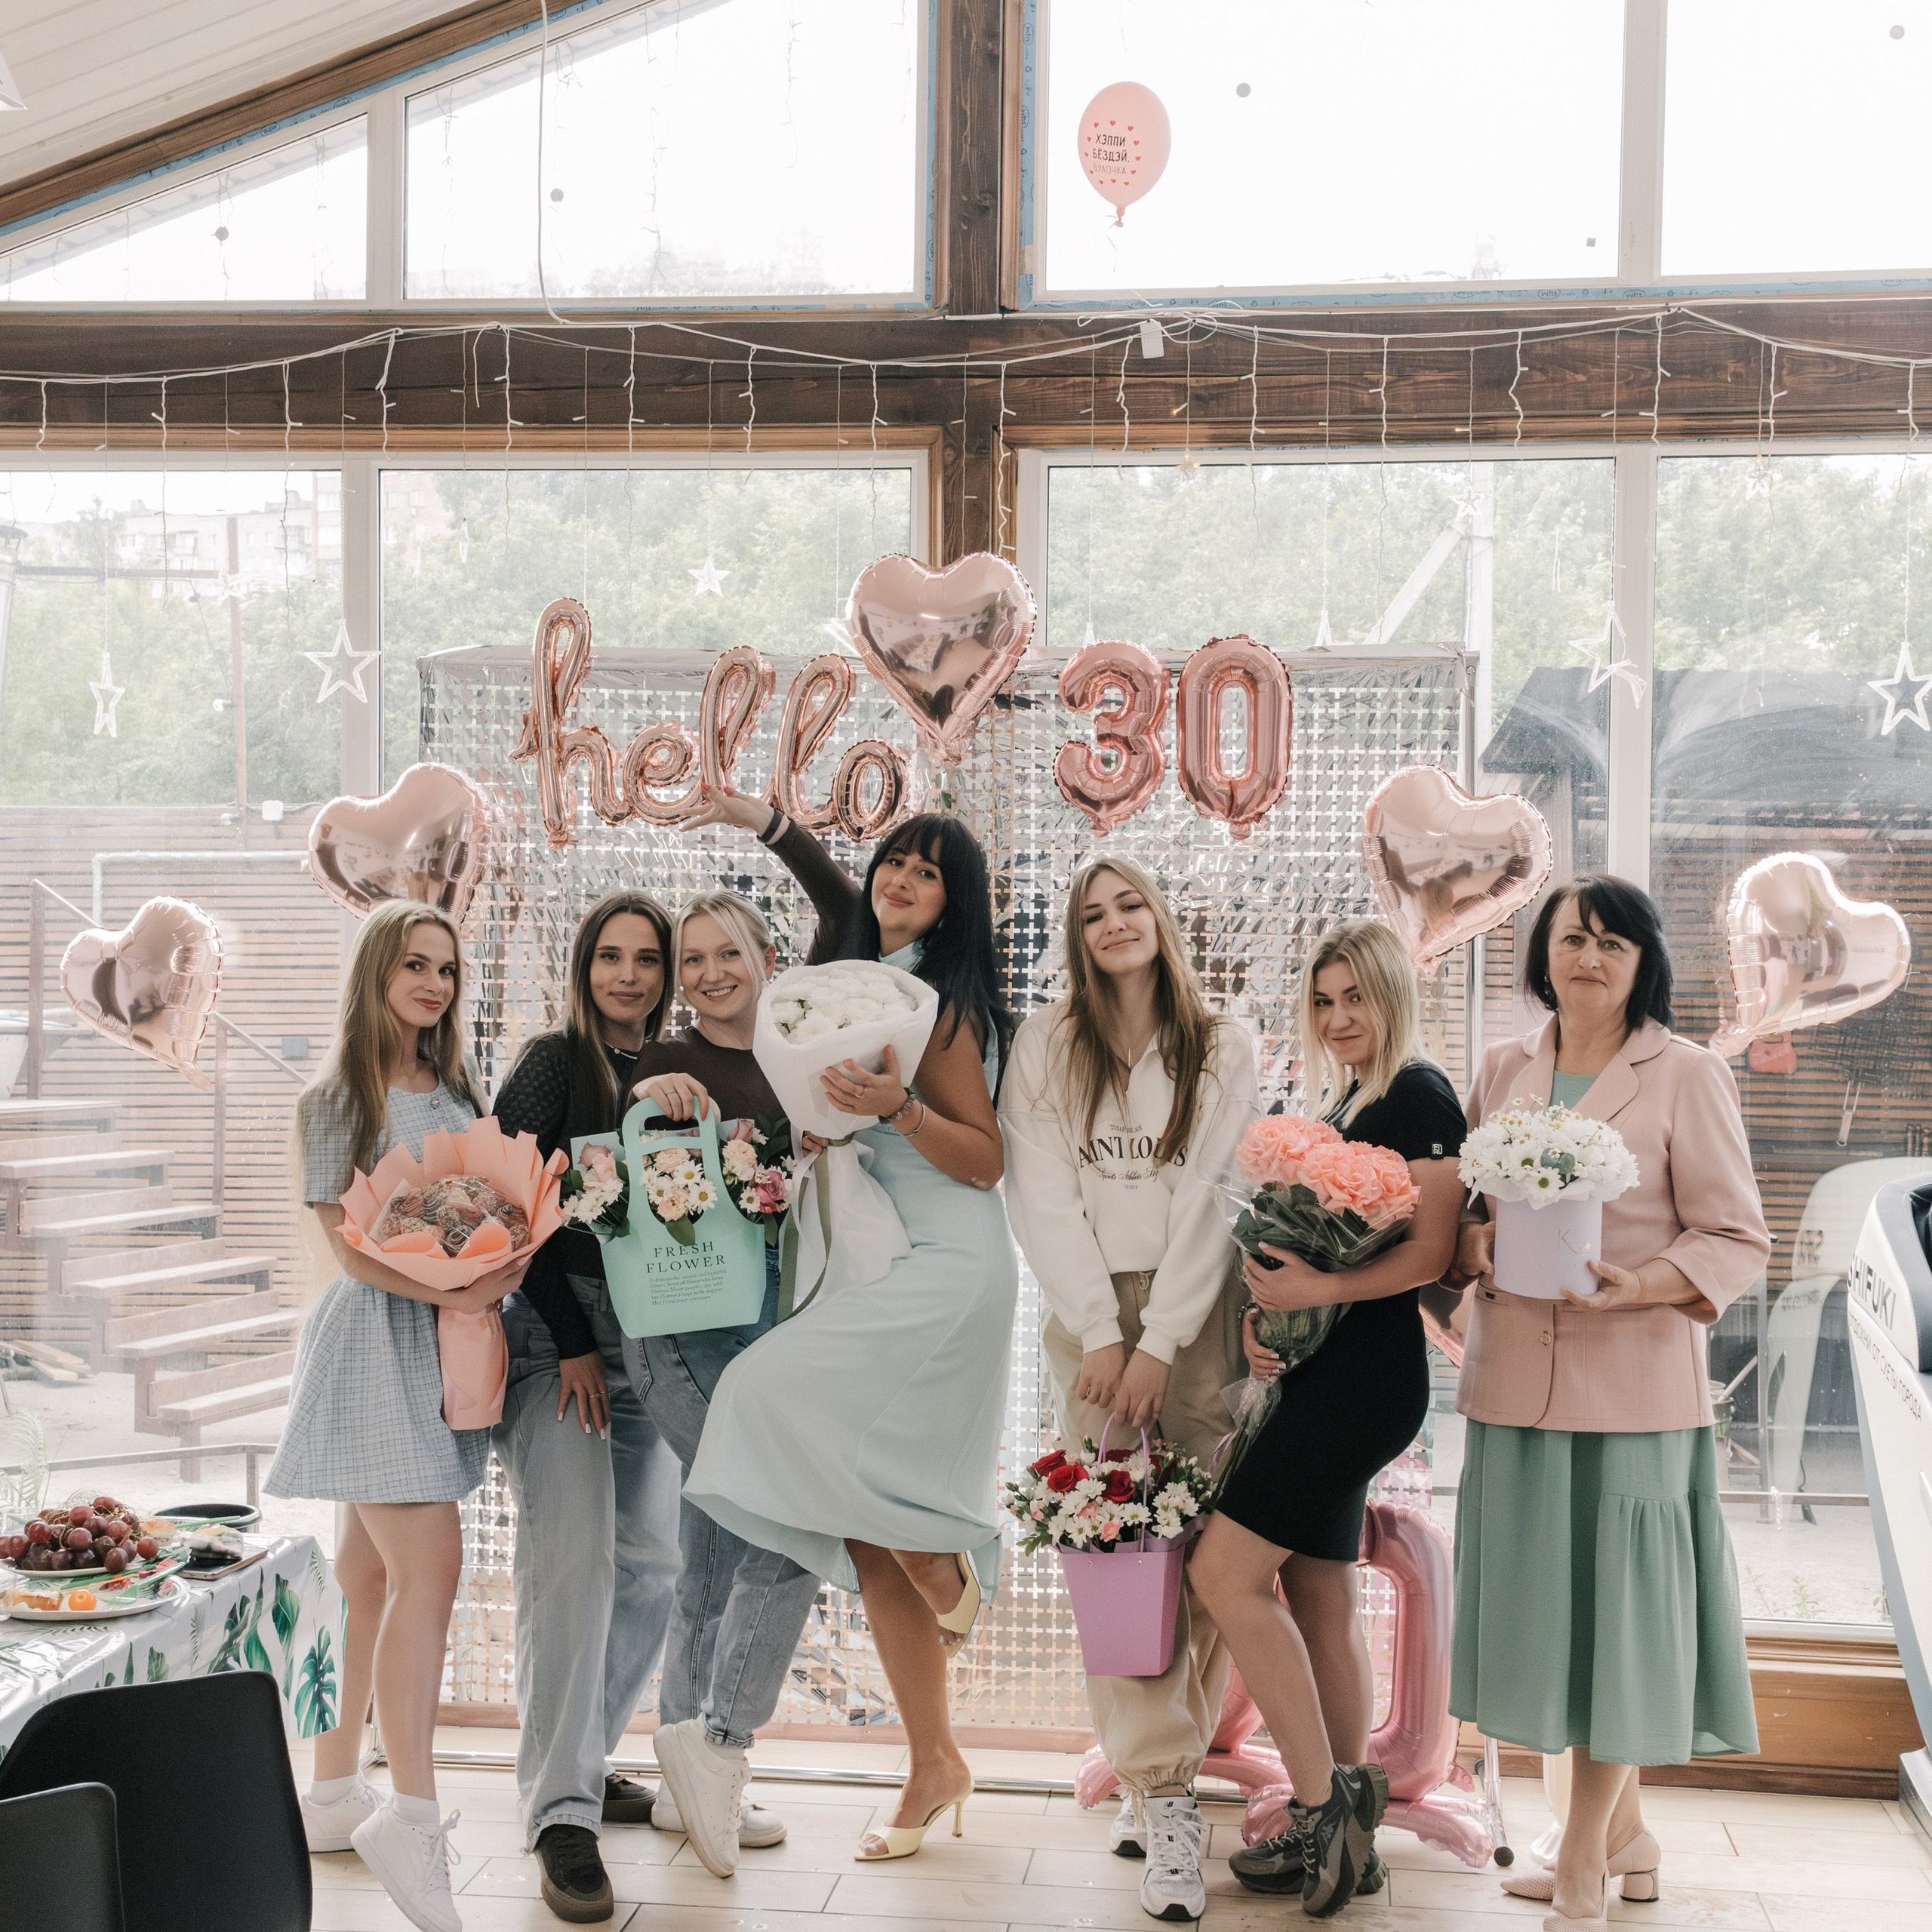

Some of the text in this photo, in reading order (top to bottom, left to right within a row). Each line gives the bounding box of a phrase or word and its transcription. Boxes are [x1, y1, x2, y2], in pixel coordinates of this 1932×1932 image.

[1095, 134, 1126, 147] ХЭППИ
[1094, 163, 1127, 175] БУЛОЧКА
[515, 596, 1293, 845] hello 30
[654, 1241, 714, 1258] FRESH
[645, 1254, 726, 1274] FLOWER
